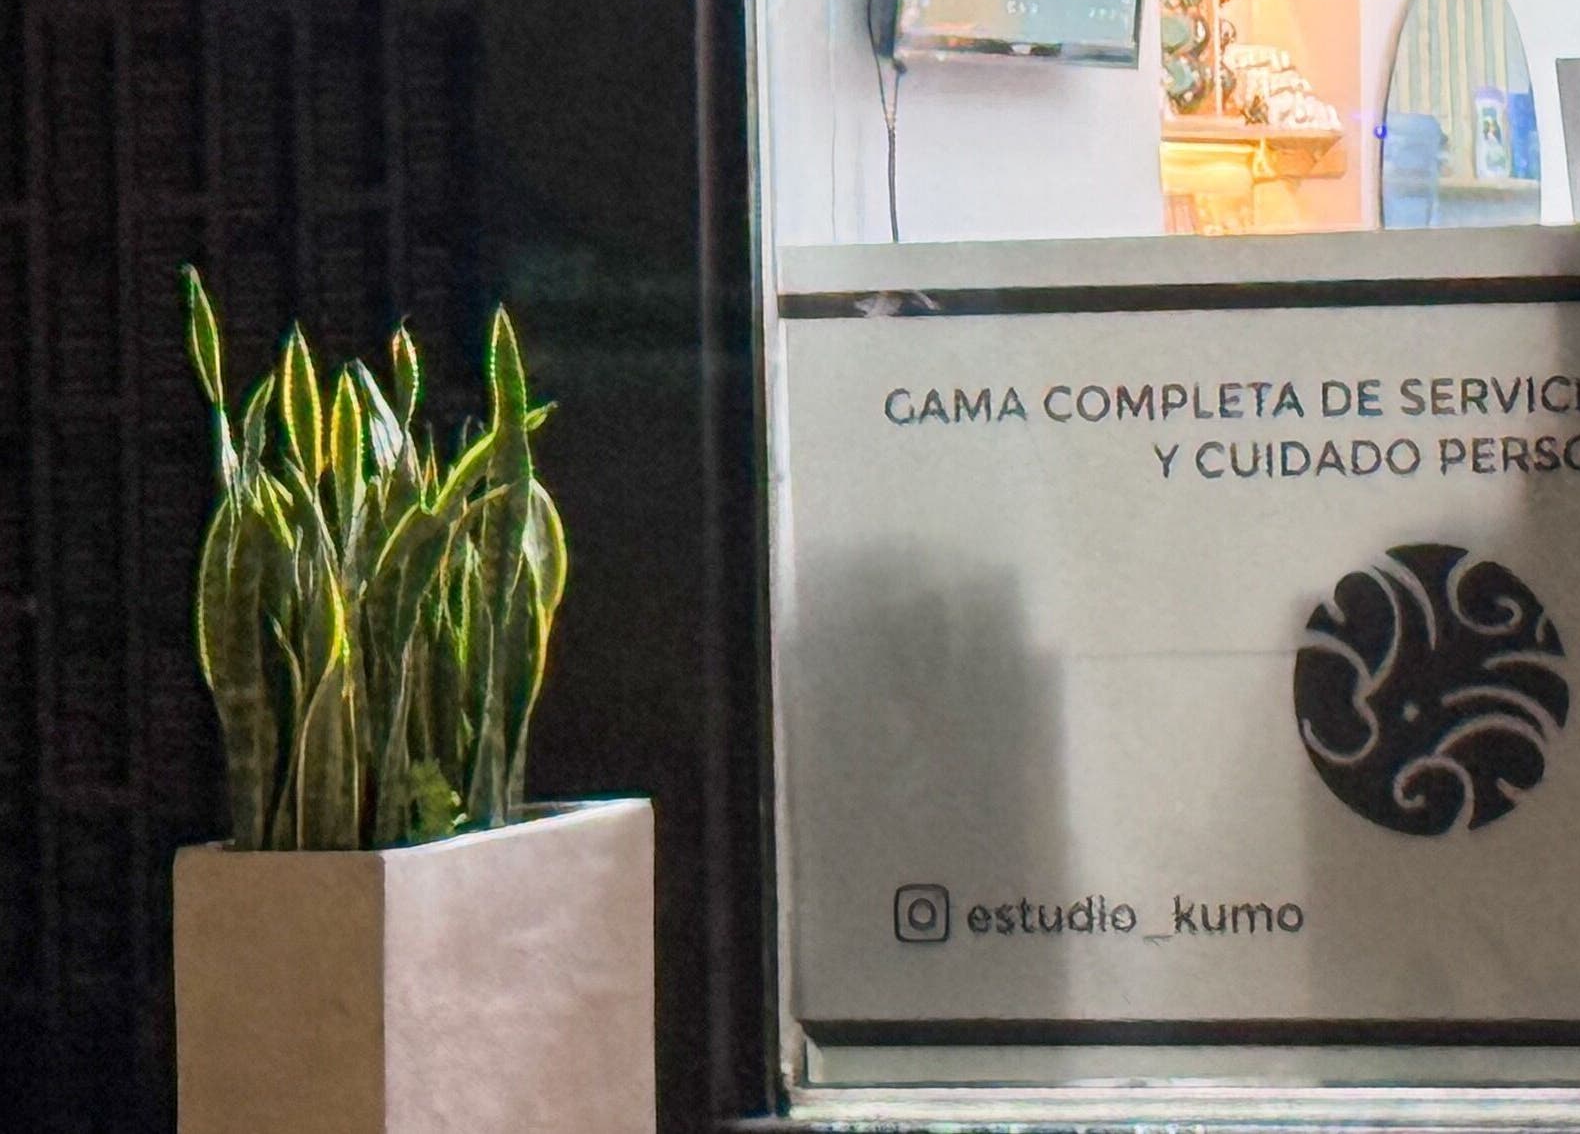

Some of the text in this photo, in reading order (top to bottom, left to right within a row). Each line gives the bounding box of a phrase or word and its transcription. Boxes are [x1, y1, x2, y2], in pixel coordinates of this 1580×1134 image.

[884, 386, 1028, 425] GAMA
[1043, 379, 1305, 423] COMPLETA
[1320, 378, 1383, 418] DE
[1151, 442, 1180, 479] Y
[1195, 437, 1421, 479] CUIDADO
